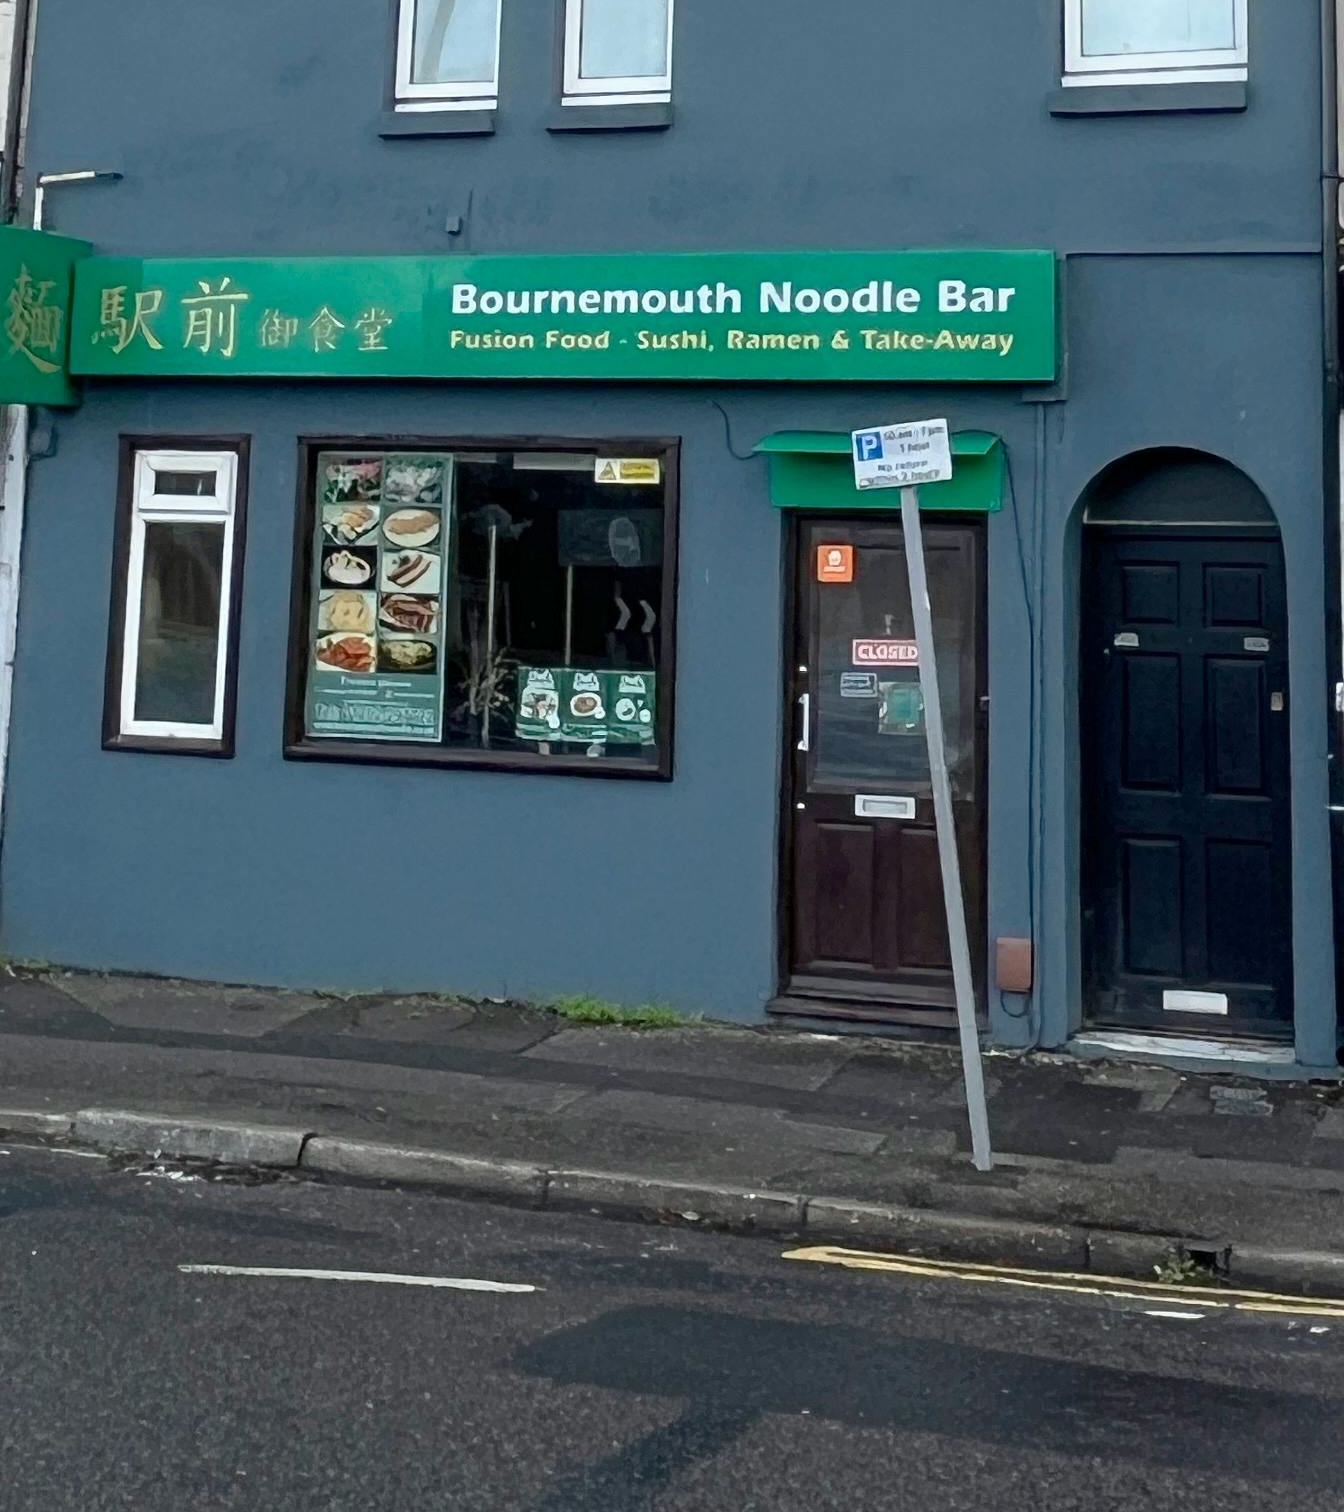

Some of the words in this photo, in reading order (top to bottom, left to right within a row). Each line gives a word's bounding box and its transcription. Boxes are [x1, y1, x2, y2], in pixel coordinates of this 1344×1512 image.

[452, 282, 742, 314] Bournemouth
[760, 280, 921, 313] Noodle
[938, 280, 1015, 313] Bar
[91, 277, 249, 357] 駅前
[450, 330, 534, 349] Fusion
[545, 330, 610, 349] Food
[637, 330, 714, 352] Sushi,
[727, 330, 820, 350] Ramen
[831, 330, 849, 350] &
[860, 329, 1013, 356] Take-Away
